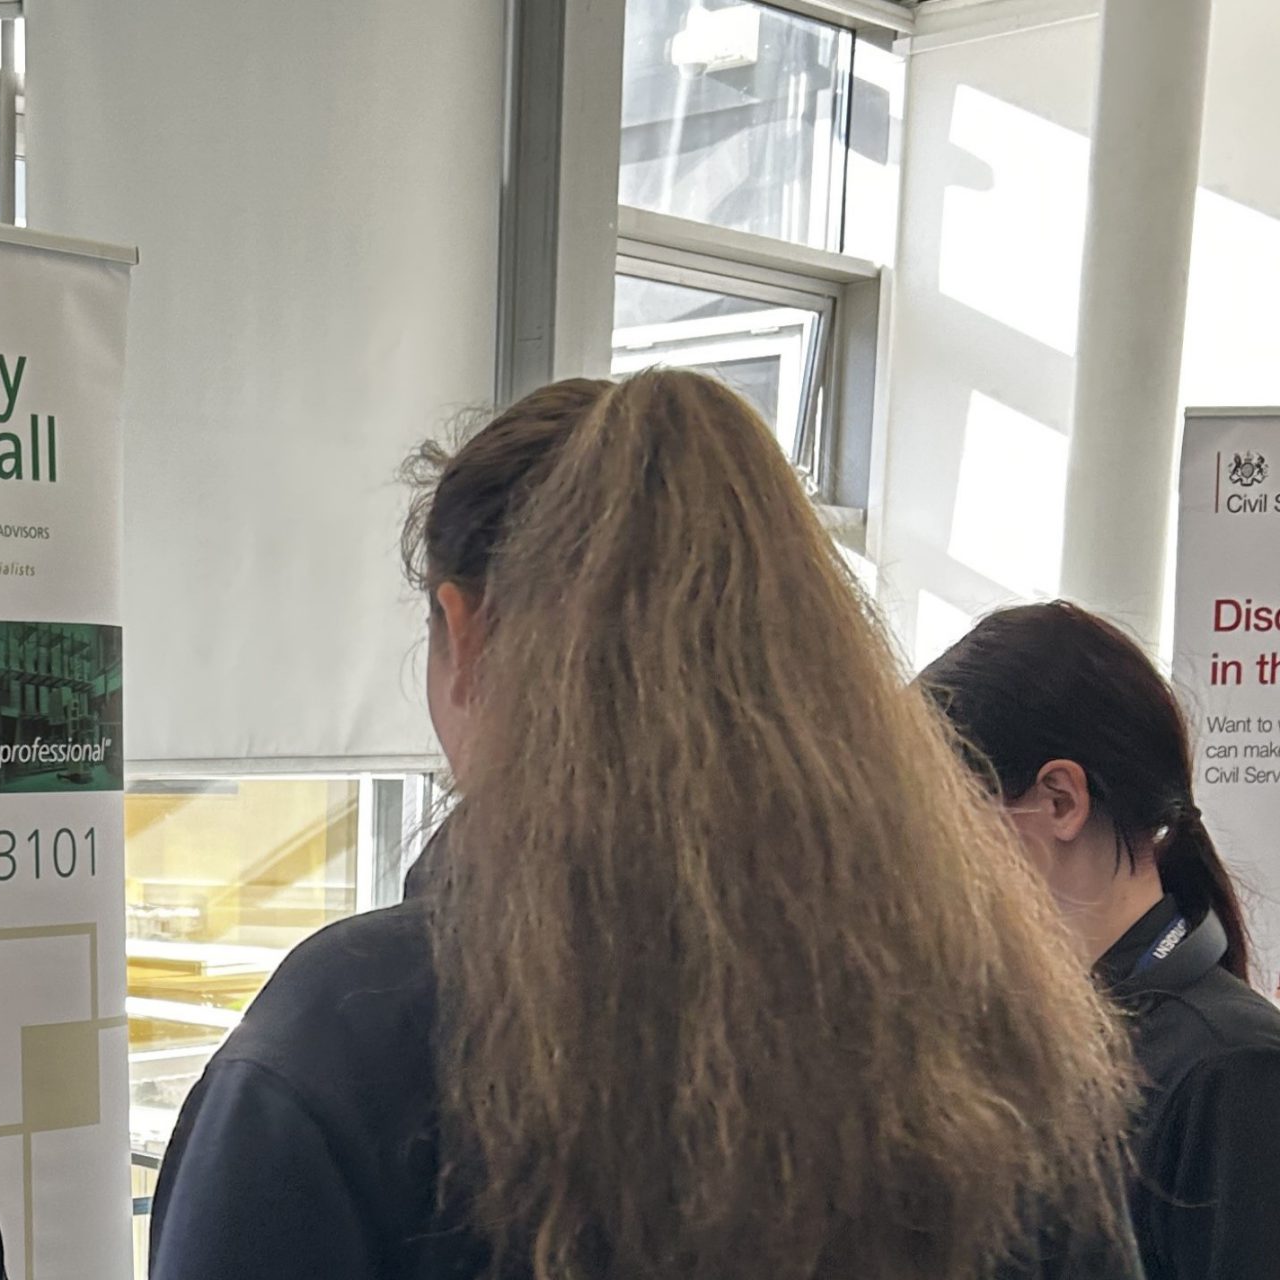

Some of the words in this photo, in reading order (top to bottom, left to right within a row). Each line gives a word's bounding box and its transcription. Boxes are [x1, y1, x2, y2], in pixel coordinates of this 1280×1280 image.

[1226, 493, 1268, 513] Civil
[1214, 599, 1280, 632] Dis
[1211, 652, 1242, 685] in
[1206, 716, 1251, 733] Want
[1257, 716, 1272, 733] to
[1206, 745, 1237, 758] can
[1243, 741, 1280, 758] mak
[1205, 766, 1239, 784] Civil
